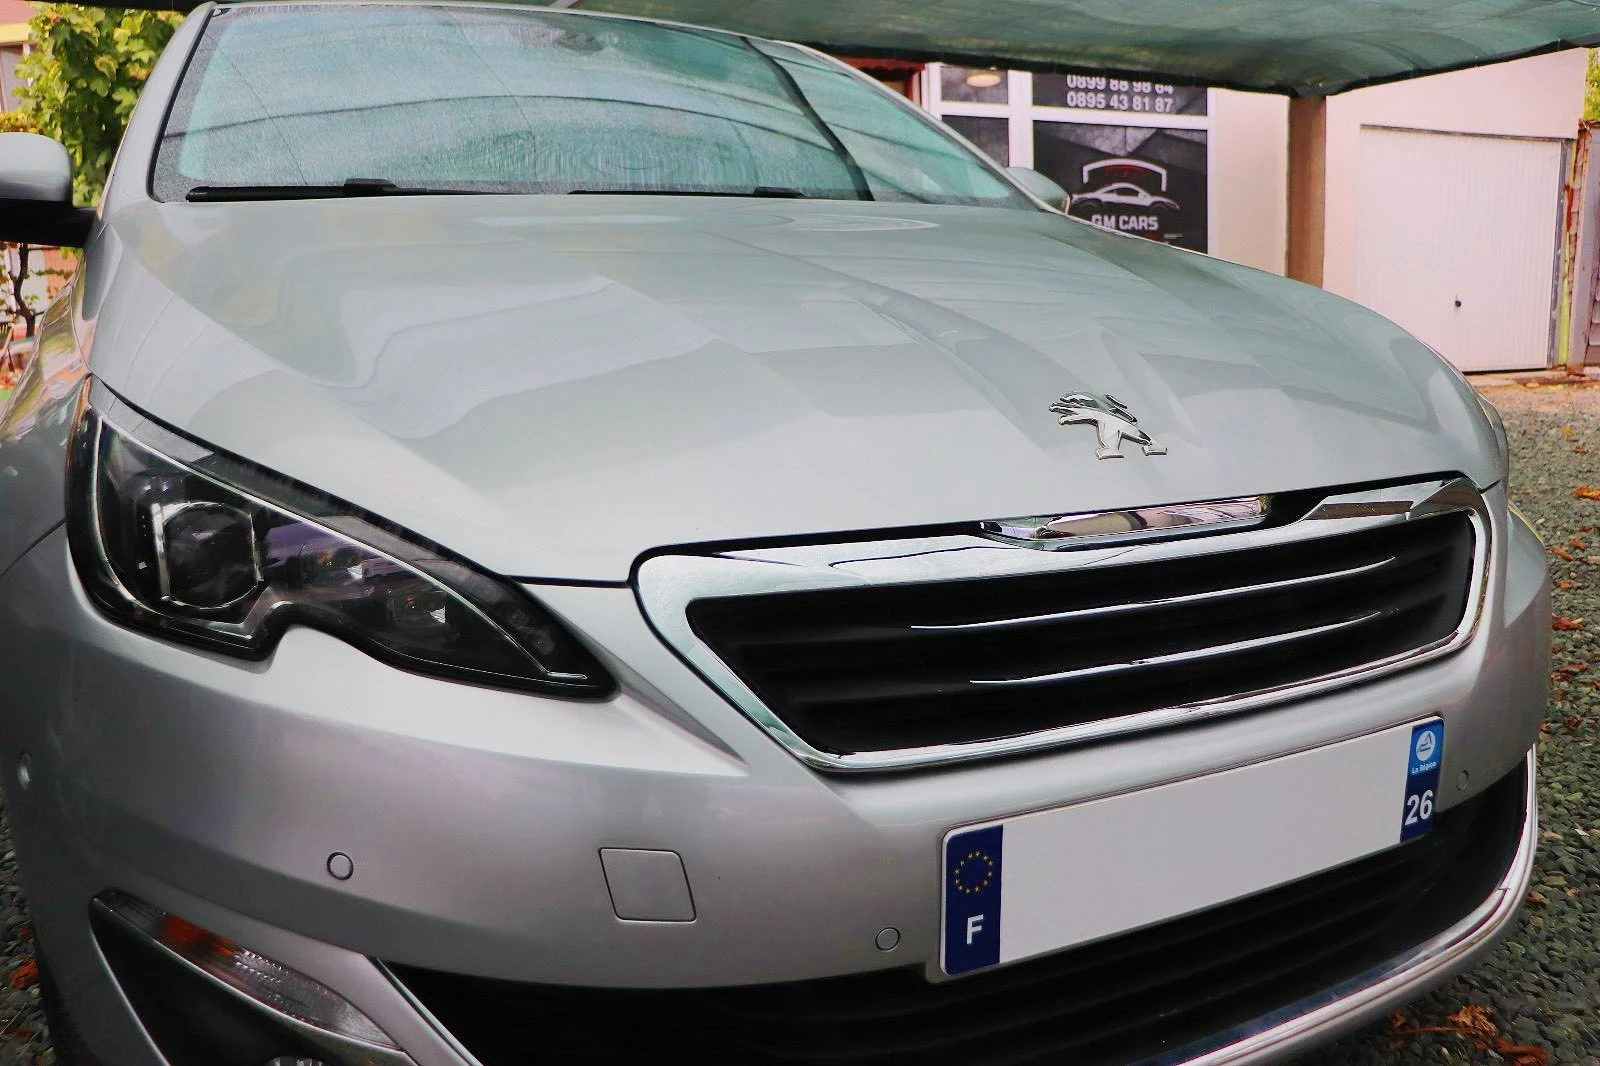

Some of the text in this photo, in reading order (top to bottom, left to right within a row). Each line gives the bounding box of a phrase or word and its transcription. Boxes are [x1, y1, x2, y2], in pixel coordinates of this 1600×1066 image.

[1066, 74, 1106, 90] 0899
[1066, 91, 1174, 113] 0895 43 81 87
[1118, 215, 1158, 231] CARS
[1404, 789, 1433, 826] 26
[966, 914, 984, 945] F
